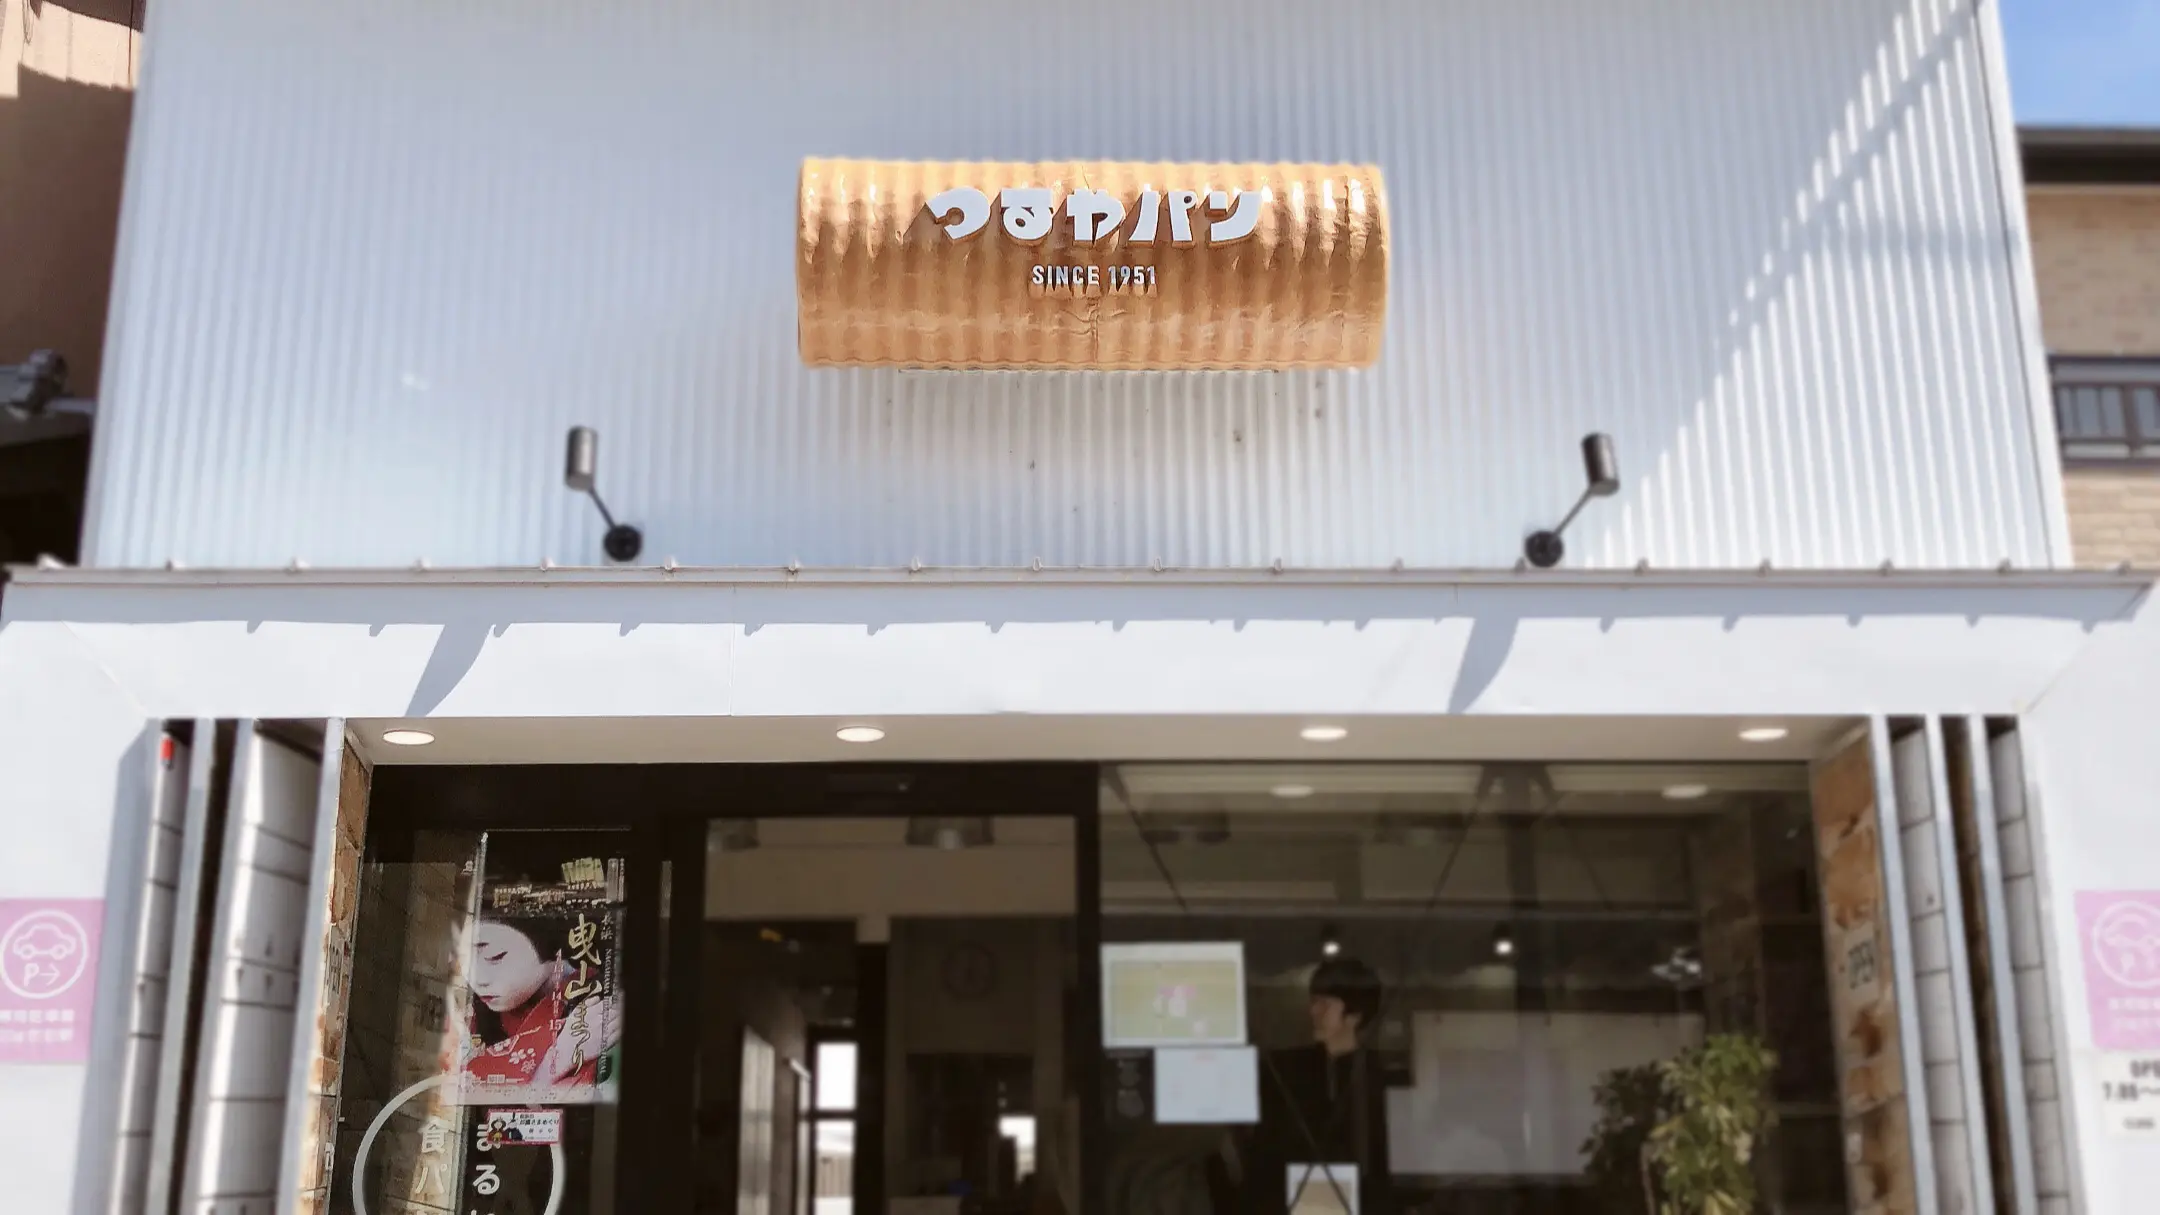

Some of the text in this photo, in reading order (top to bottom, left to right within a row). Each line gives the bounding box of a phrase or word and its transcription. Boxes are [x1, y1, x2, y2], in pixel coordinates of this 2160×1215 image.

[924, 186, 1261, 243] つるやパン
[1032, 264, 1157, 287] SINCE 1951
[563, 912, 603, 1077] 曳山まつり
[415, 1115, 450, 1215] 食パ
